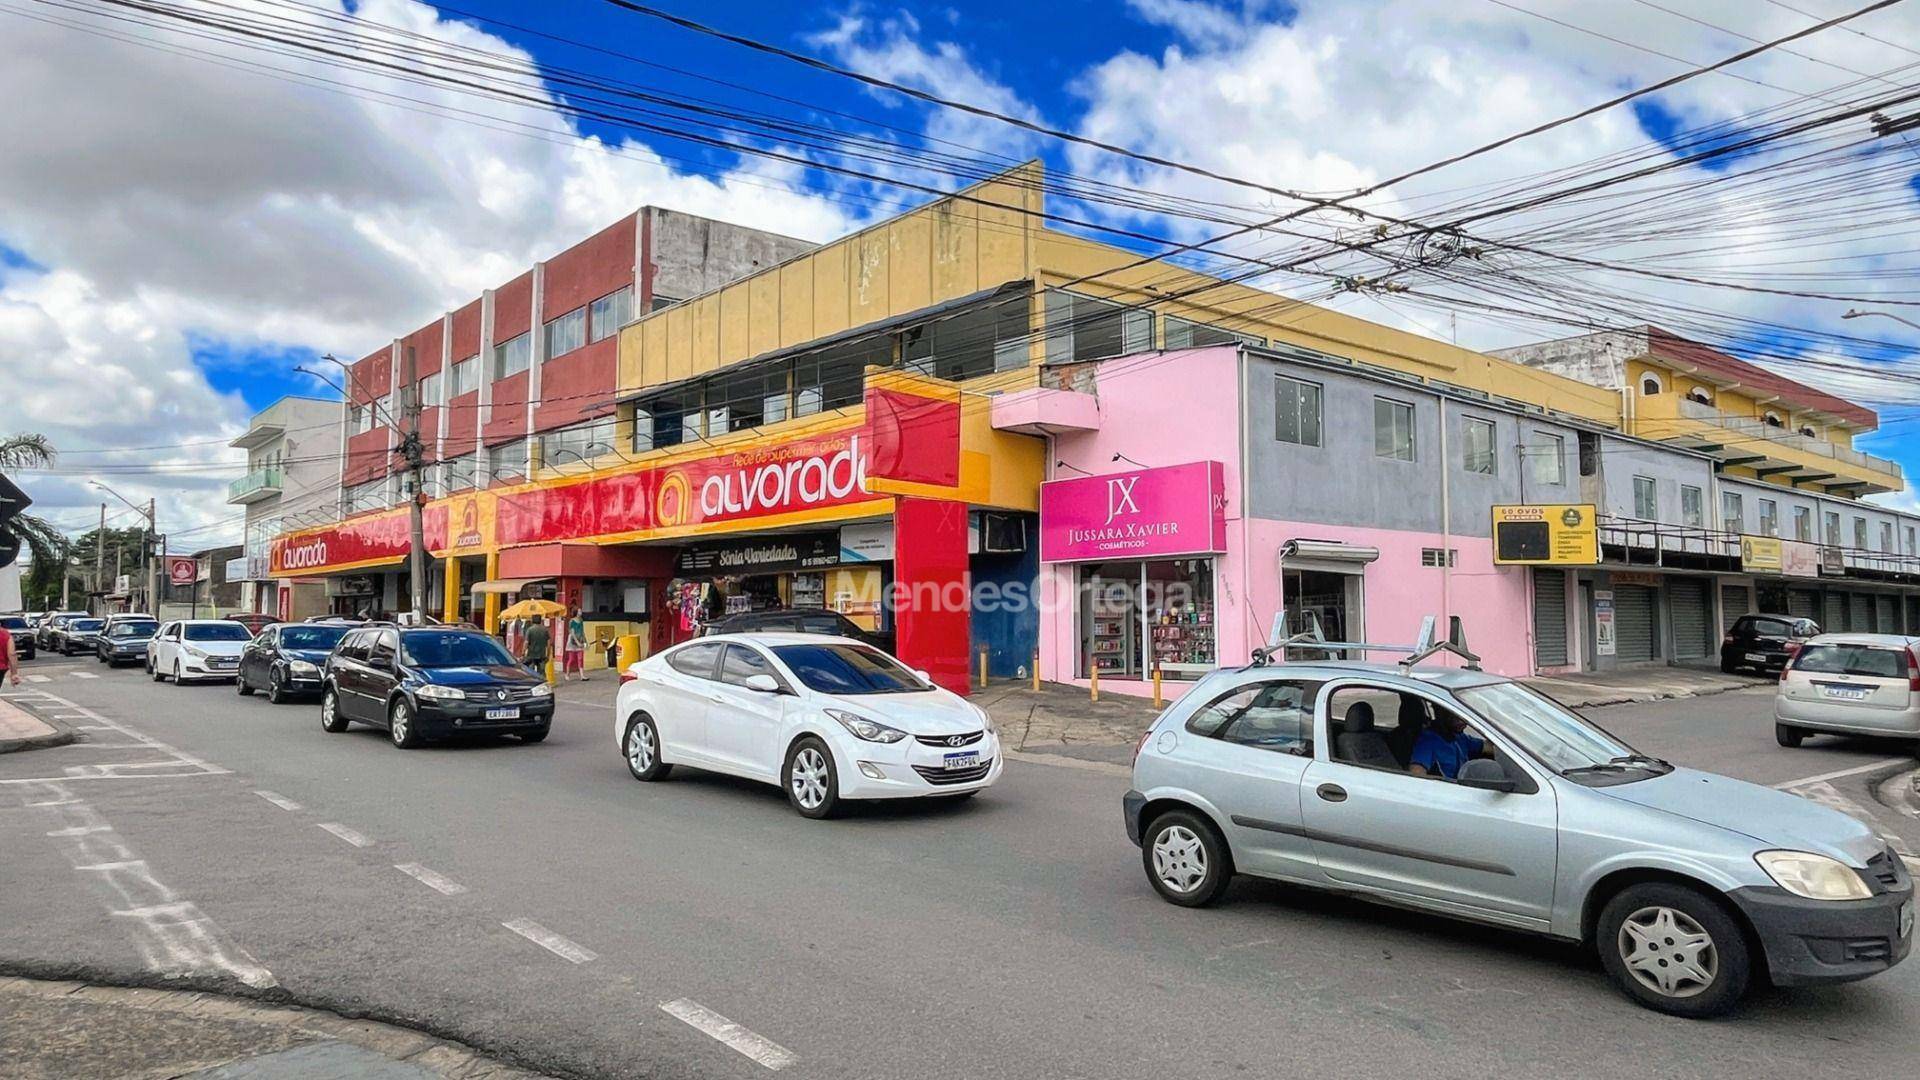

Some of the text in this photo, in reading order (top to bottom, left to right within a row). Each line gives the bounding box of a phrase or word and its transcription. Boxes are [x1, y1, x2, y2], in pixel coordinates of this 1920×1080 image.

[1104, 475, 1141, 525] JX
[1068, 522, 1179, 546] JUSSARA XAVIER
[744, 544, 798, 565] Variedades
